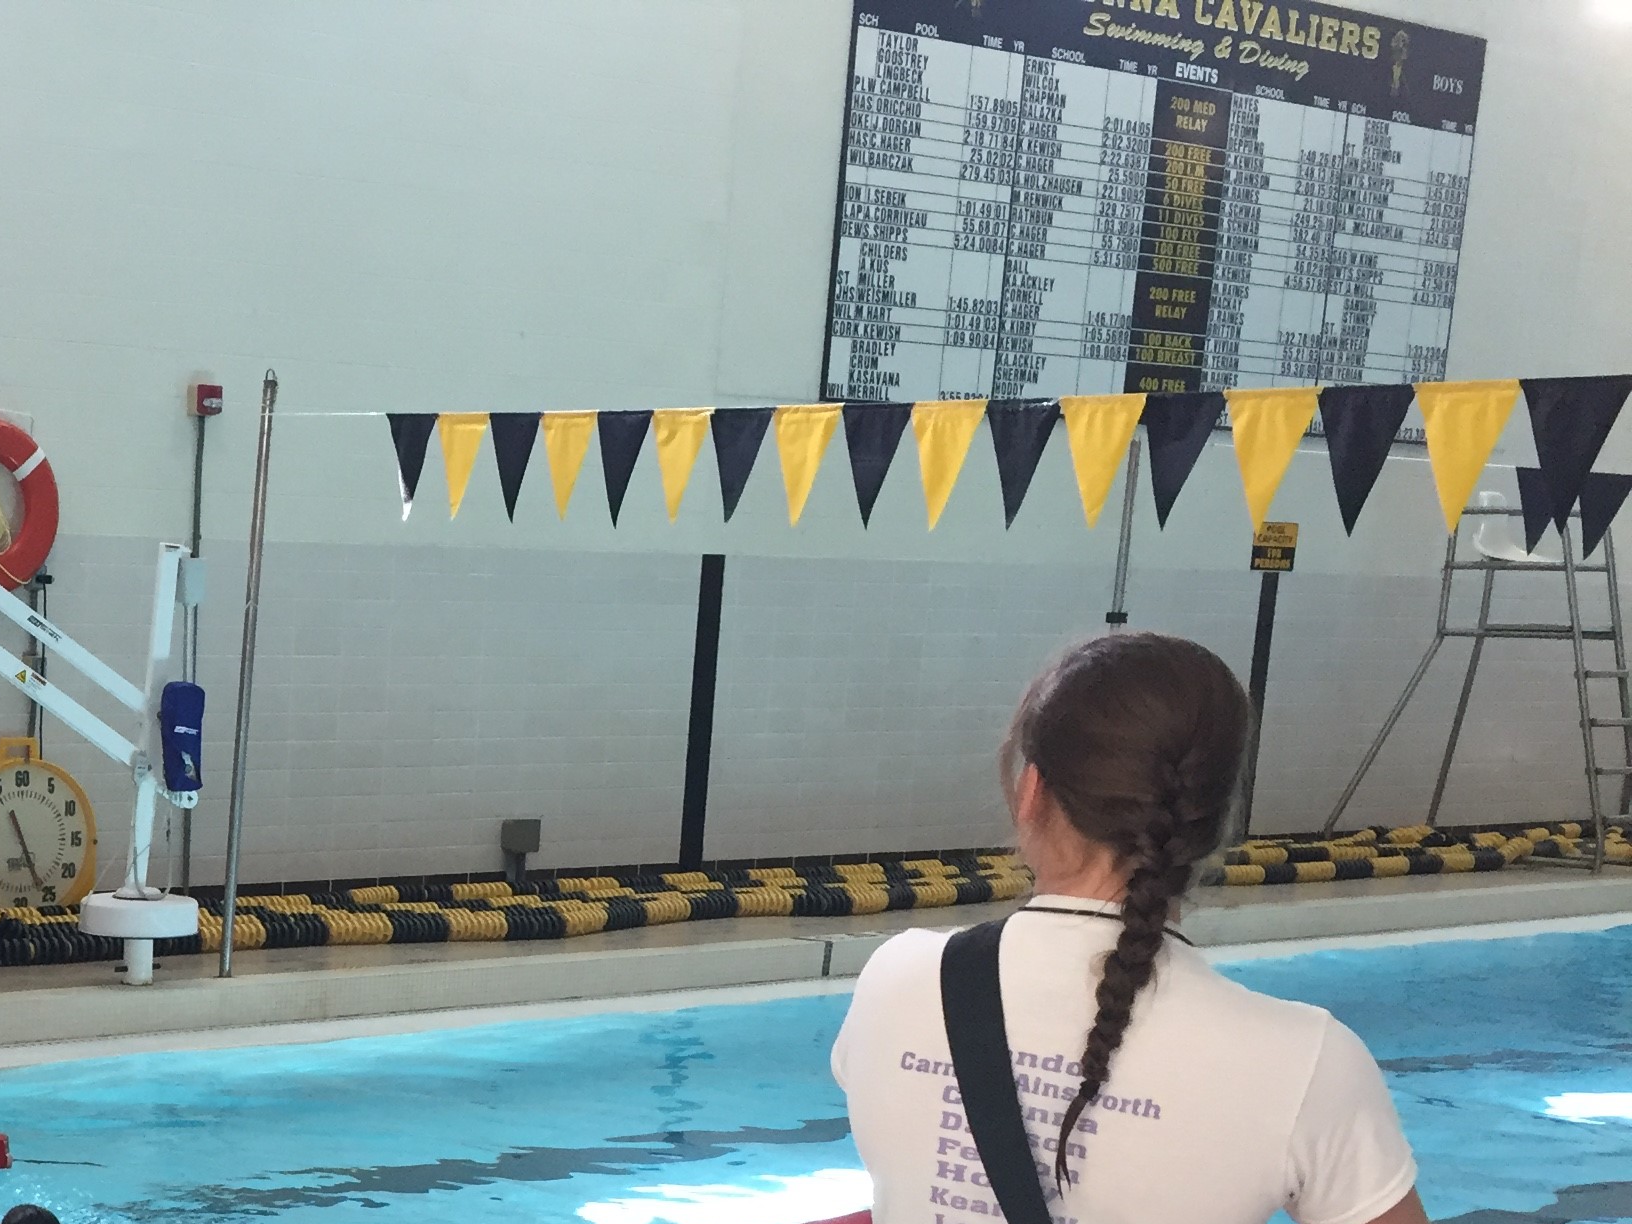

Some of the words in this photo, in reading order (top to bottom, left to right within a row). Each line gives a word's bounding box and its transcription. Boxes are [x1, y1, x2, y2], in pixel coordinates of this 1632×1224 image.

[858, 12, 879, 26] SCH
[915, 22, 940, 37] POOL
[982, 34, 1003, 49] TIME
[1012, 39, 1024, 52] YR
[1194, 0, 1381, 60] CAVALIERS
[879, 31, 918, 53] TAYLOR
[1083, 12, 1205, 61] Swimming
[1214, 35, 1232, 59] &
[1238, 40, 1310, 81] Diving
[877, 47, 928, 70] GOOSTREY
[1025, 58, 1056, 76] ERNST
[1051, 46, 1086, 63] SCHOOL
[1118, 58, 1138, 73] TIME
[1146, 63, 1158, 76] YR
[876, 62, 923, 85] LINGBECK
[1175, 61, 1218, 84] EVENTS
[879, 79, 931, 102] CAMPBELL
[1024, 73, 1059, 92] WILCOX
[1432, 74, 1465, 96] BOYS
[1023, 87, 1066, 108] CHAPMAN
[1255, 84, 1285, 99] SCHOOL
[1313, 95, 1330, 107] TIME
[853, 93, 873, 111] HAS
[875, 96, 921, 118] ORICCHIO
[1170, 95, 1190, 112] 200
[1192, 99, 1215, 116] MED
[1175, 114, 1207, 132] RELAY
[1187, 146, 1211, 162] FREE
[1165, 159, 1184, 174] 200
[1165, 176, 1178, 190] 50
[1180, 178, 1205, 194] FREE
[1162, 193, 1169, 205] 6
[1173, 194, 1203, 210] DIVES
[1158, 209, 1168, 222] 11
[1174, 211, 1204, 226] DIVES
[1160, 225, 1178, 240] 100
[1181, 228, 1199, 242] FLY
[861, 241, 907, 261] CHILDERS
[1154, 241, 1173, 255] 100
[1176, 244, 1200, 258] FREE
[1152, 257, 1172, 271] 500
[1174, 260, 1198, 274] FREE
[837, 269, 850, 285] ST
[858, 272, 895, 289] MILLER
[1003, 287, 1044, 305] CORNELL
[1149, 286, 1169, 300] 200
[1171, 288, 1196, 303] FREE
[834, 302, 852, 318] WIL
[1154, 304, 1186, 319] RELAY
[851, 339, 896, 356] BRADLEY
[1143, 332, 1161, 345] 100
[1164, 334, 1191, 348] BACK
[850, 354, 878, 370] CRUM
[1135, 347, 1153, 361] 100
[1156, 349, 1195, 365] BREAST
[848, 368, 901, 387] KASAVANA
[996, 366, 1039, 383] SHERMAN
[847, 384, 890, 401] MERRILL
[1139, 376, 1159, 391] 400
[1161, 378, 1185, 393] FREE
[15, 770, 30, 787] 60
[48, 777, 55, 794] 5
[65, 800, 76, 816] 10
[71, 831, 82, 847] 15
[61, 862, 76, 879] 20
[42, 886, 56, 902] 25
